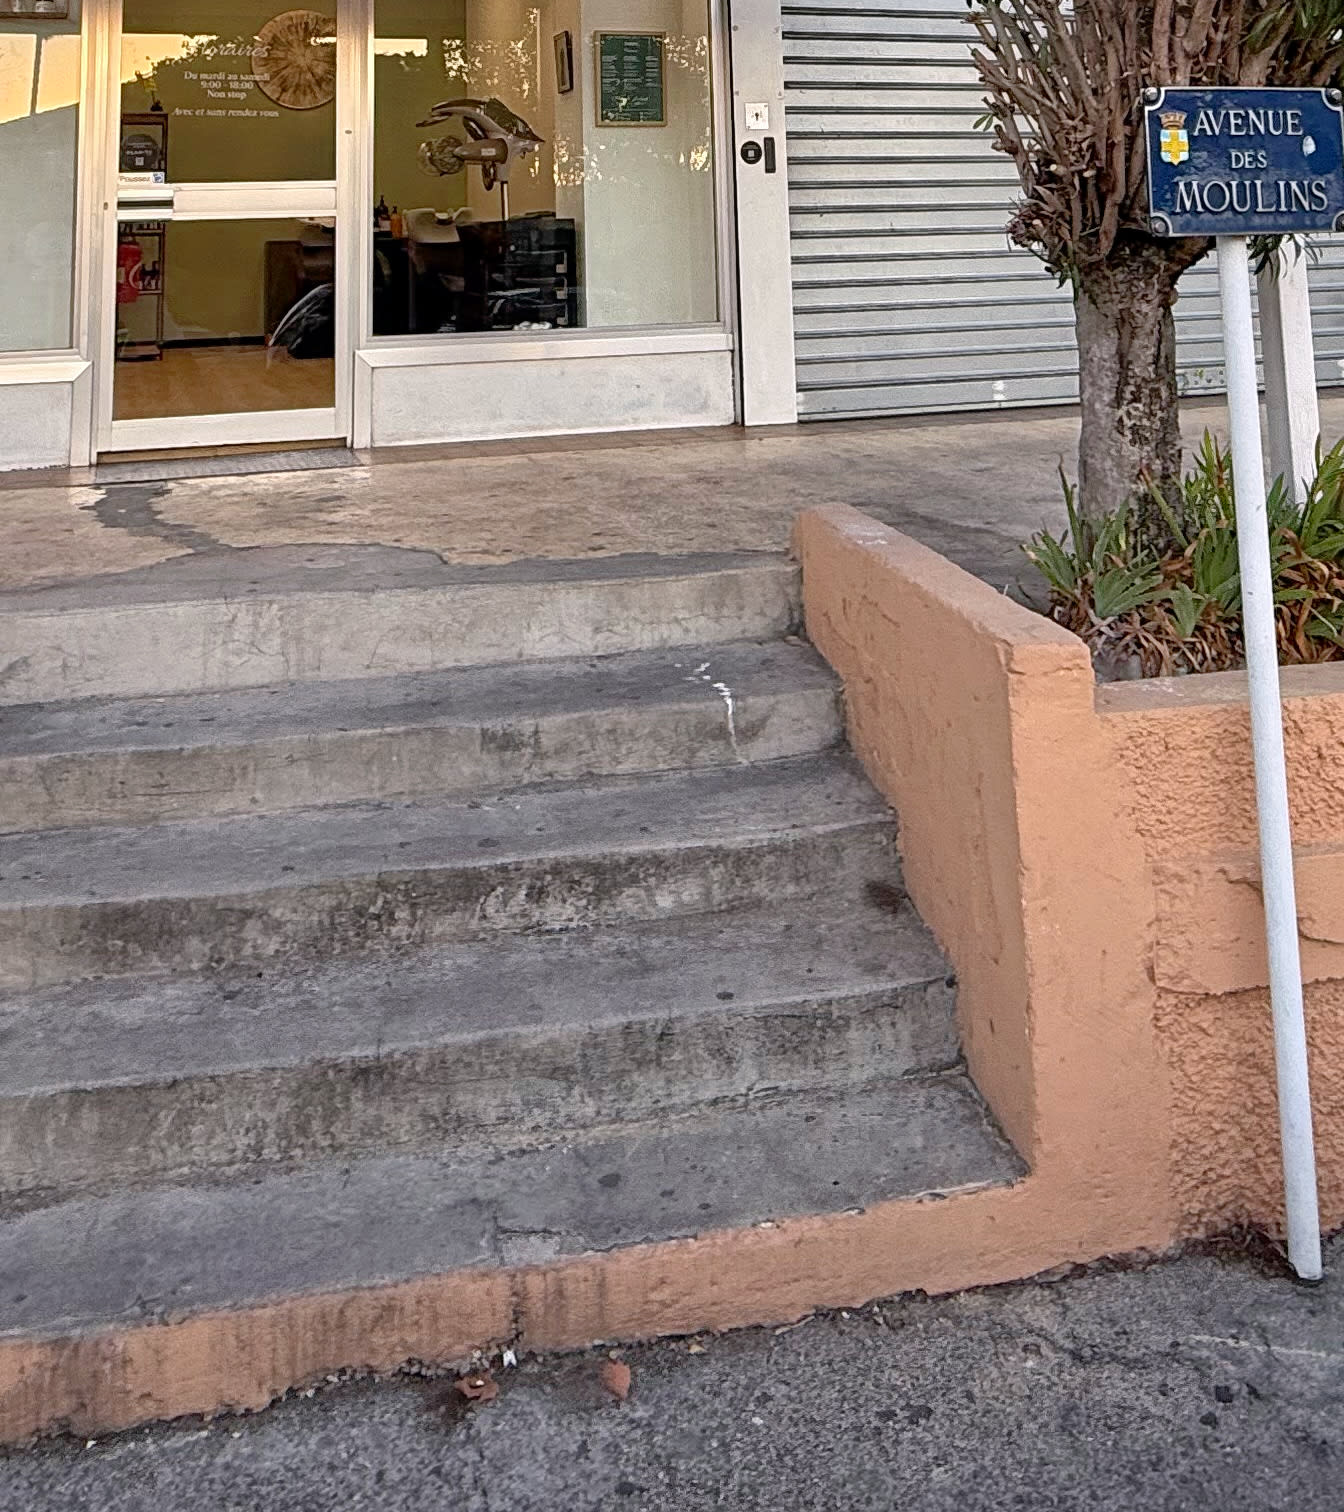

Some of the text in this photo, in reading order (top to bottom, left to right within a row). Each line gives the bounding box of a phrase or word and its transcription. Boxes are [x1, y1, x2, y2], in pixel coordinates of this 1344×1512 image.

[184, 71, 198, 80] Du
[200, 71, 226, 80] mardi
[200, 81, 222, 89] 9:00
[207, 90, 247, 100] Non stop
[172, 107, 193, 116] Avec
[1193, 109, 1303, 136] AVENUE
[1231, 151, 1268, 169] DES
[1175, 179, 1328, 213] MOULINS
